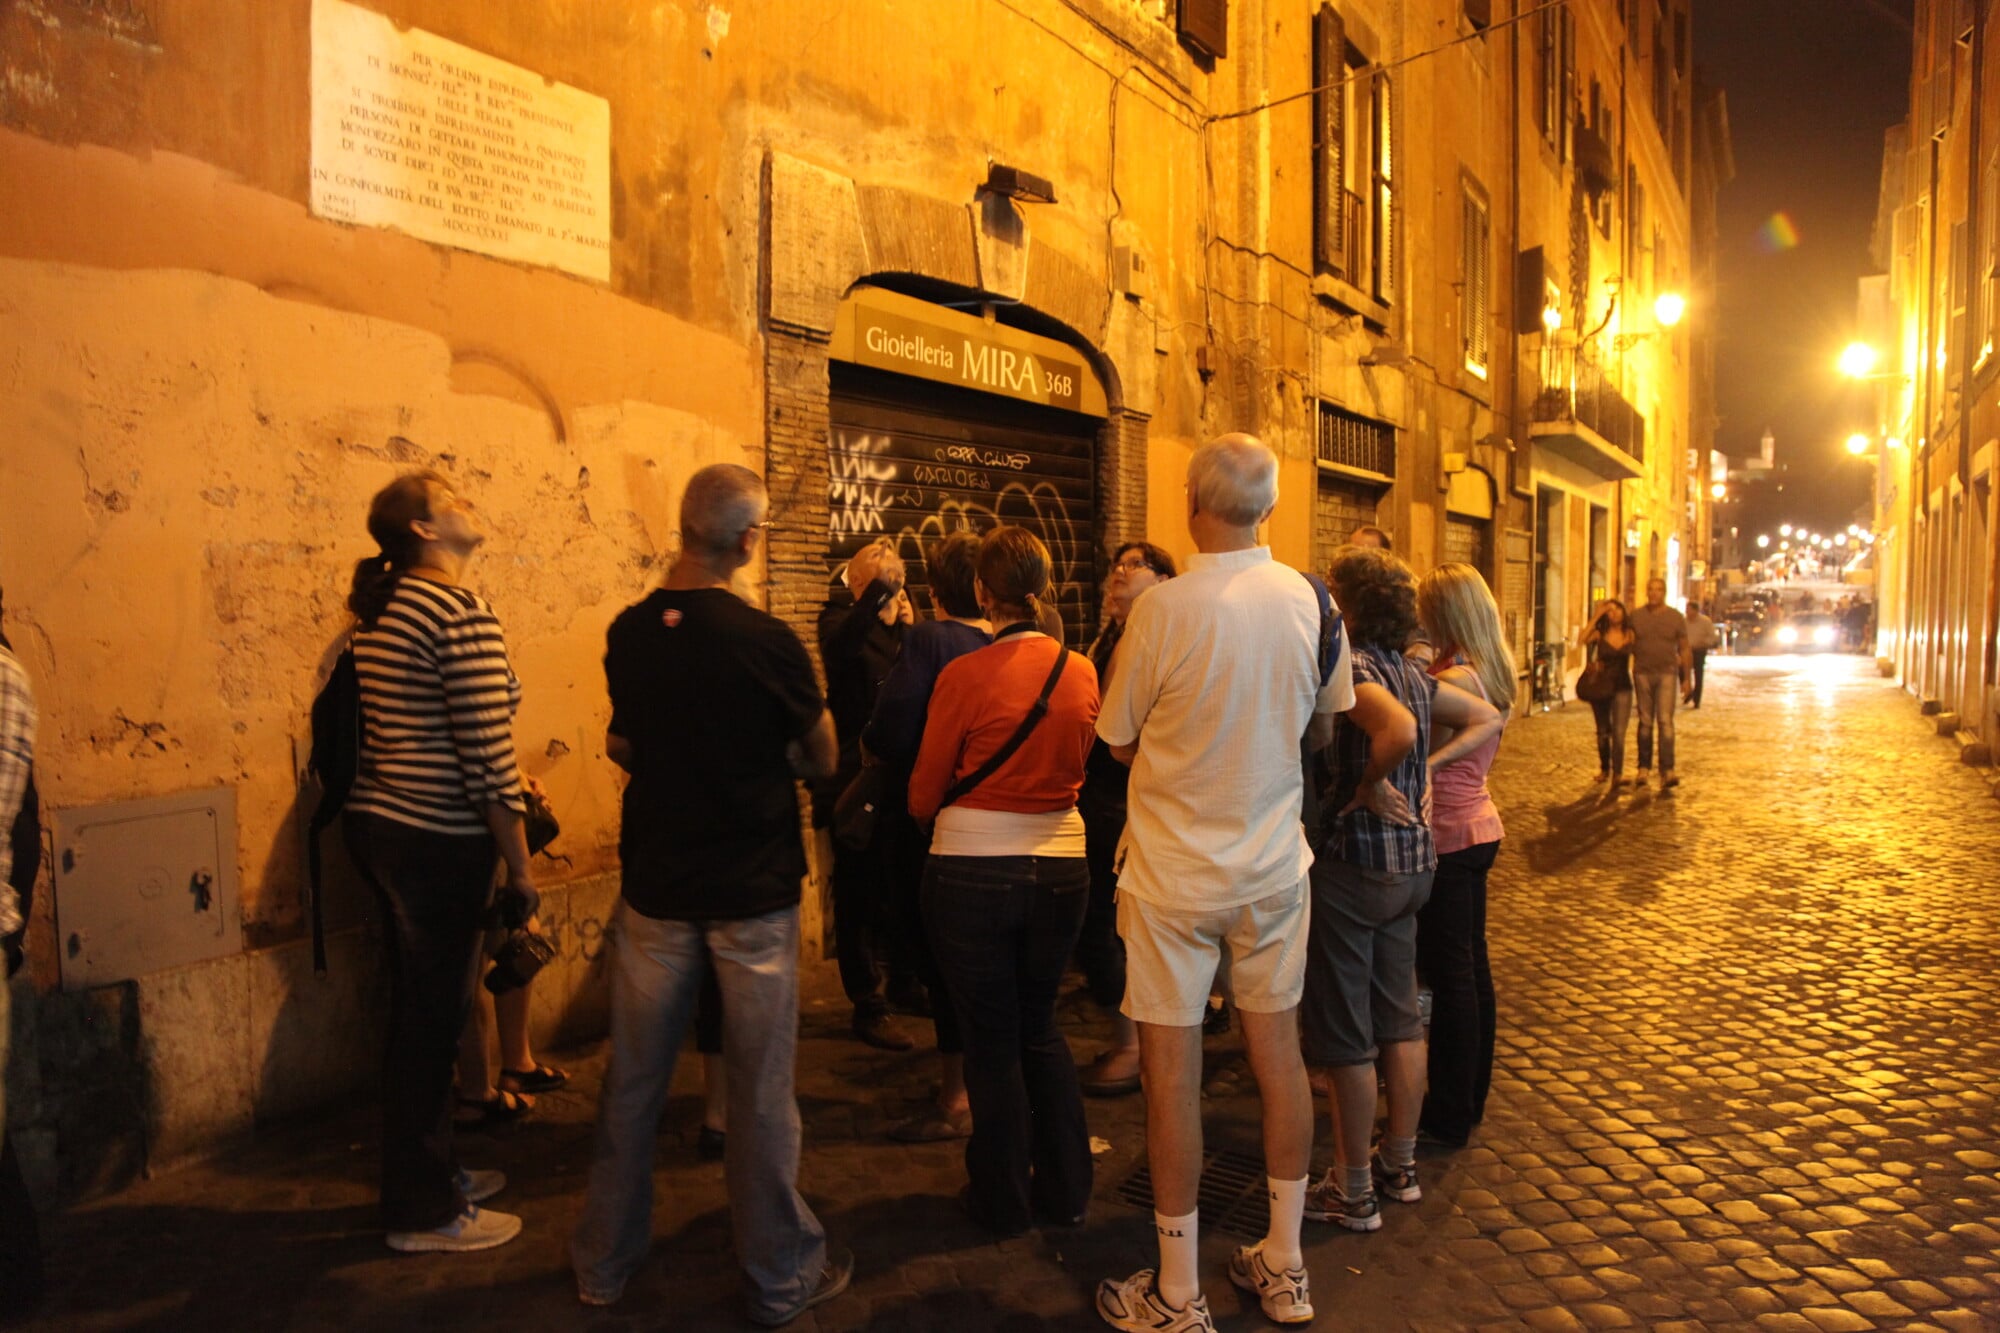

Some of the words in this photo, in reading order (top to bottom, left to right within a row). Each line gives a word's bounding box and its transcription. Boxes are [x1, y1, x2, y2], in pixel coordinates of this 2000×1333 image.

[368, 55, 379, 69] DI
[349, 104, 399, 129] PERSONA
[409, 122, 420, 135] DI
[428, 145, 440, 158] IN
[522, 141, 529, 151] A
[342, 138, 354, 152] DI
[442, 167, 456, 180] ED
[428, 180, 438, 192] DI
[314, 168, 328, 181] IN
[548, 227, 557, 238] IL
[866, 326, 954, 369] Gioielleria
[961, 340, 1038, 396] MIRA
[1045, 371, 1073, 397] 36B
